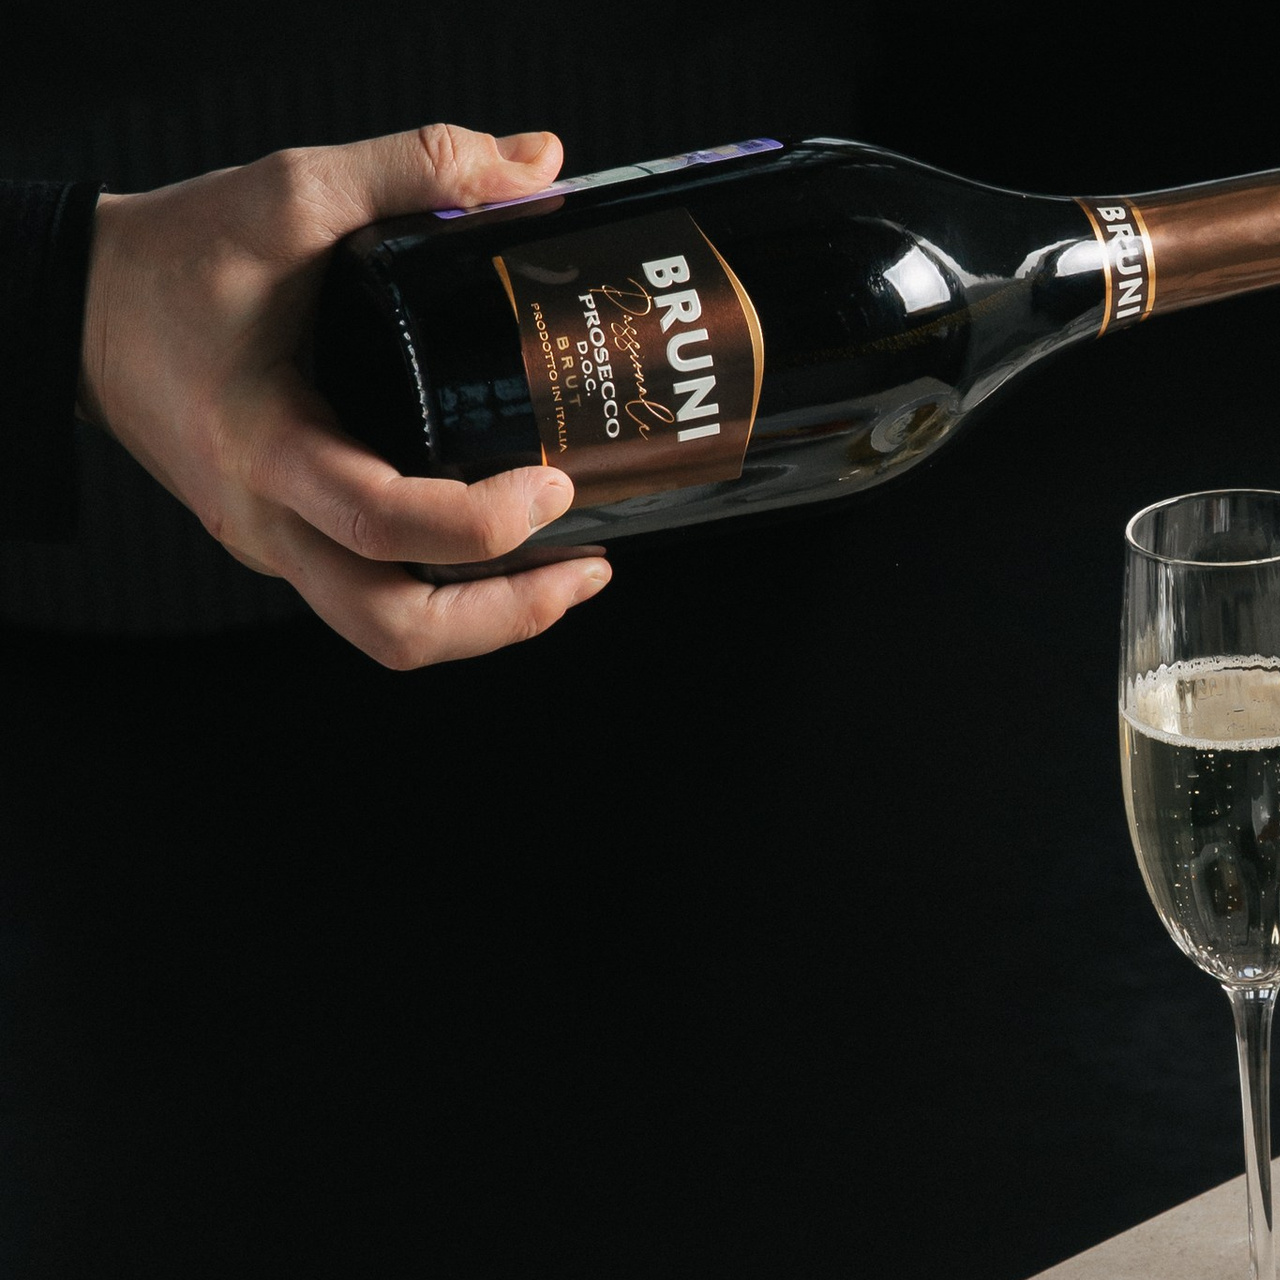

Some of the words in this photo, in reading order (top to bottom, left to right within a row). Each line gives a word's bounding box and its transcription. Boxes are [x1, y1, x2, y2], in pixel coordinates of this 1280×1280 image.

[1096, 206, 1143, 320] BRUNI
[530, 302, 558, 383] PRODOTTO
[556, 335, 582, 408] BRUT
[576, 340, 597, 397] D.O.C.
[578, 293, 621, 438] PROSECCO
[589, 277, 675, 441] Passionale
[642, 255, 720, 443] BRUNI
[551, 385, 563, 402] IN
[555, 405, 569, 454] ITALIA
